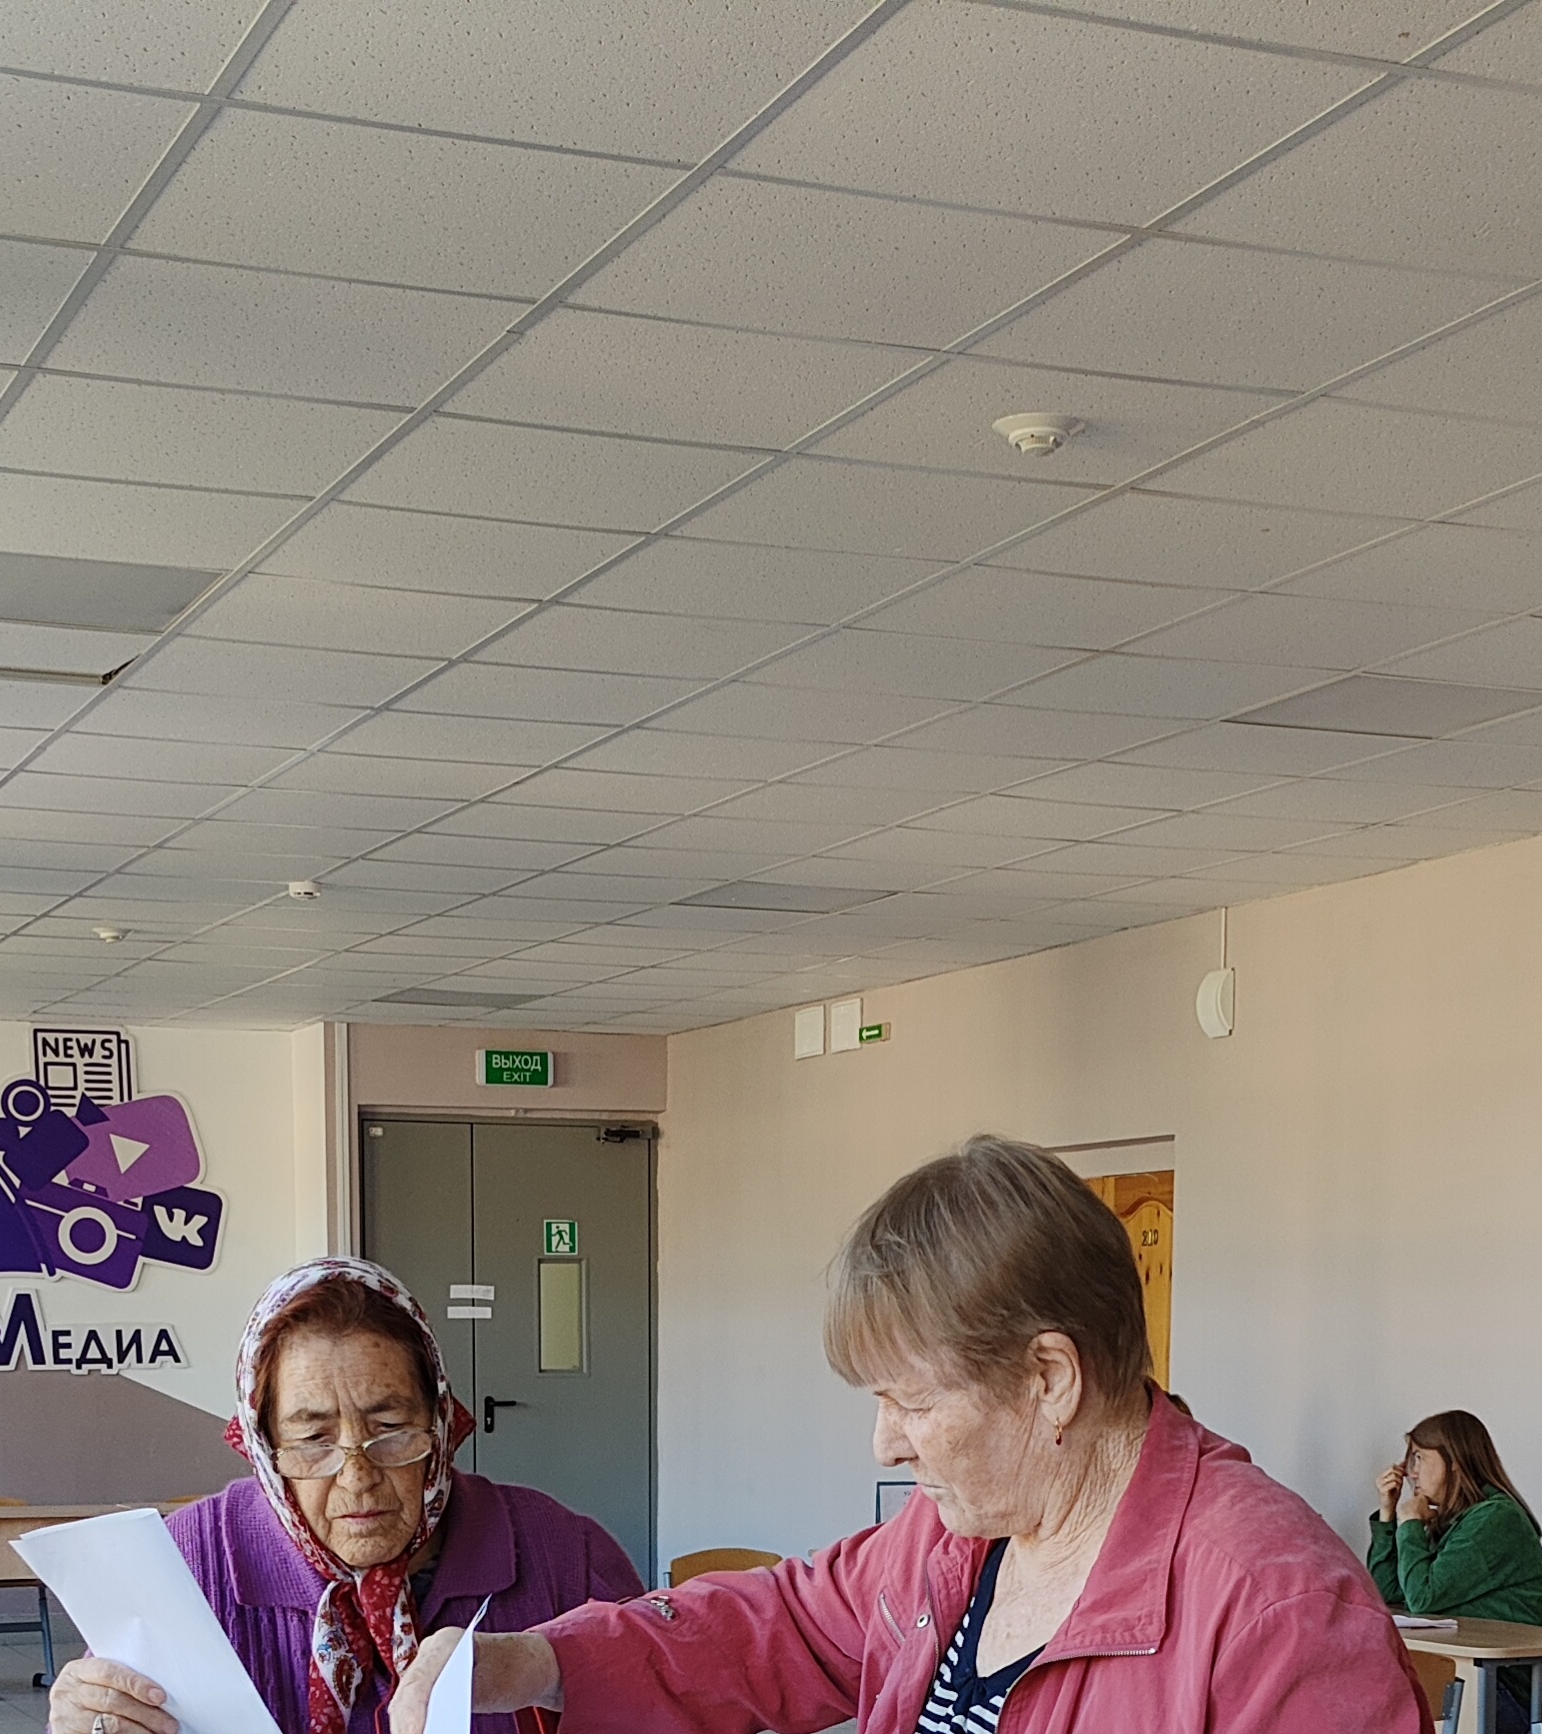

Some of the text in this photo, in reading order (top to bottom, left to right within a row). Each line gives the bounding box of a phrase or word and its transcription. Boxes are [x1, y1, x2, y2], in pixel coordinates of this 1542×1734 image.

[42, 1037, 114, 1060] NEWS
[492, 1054, 542, 1072] ВЫХОД
[503, 1071, 532, 1082] EXIT
[1141, 1229, 1159, 1247] 210
